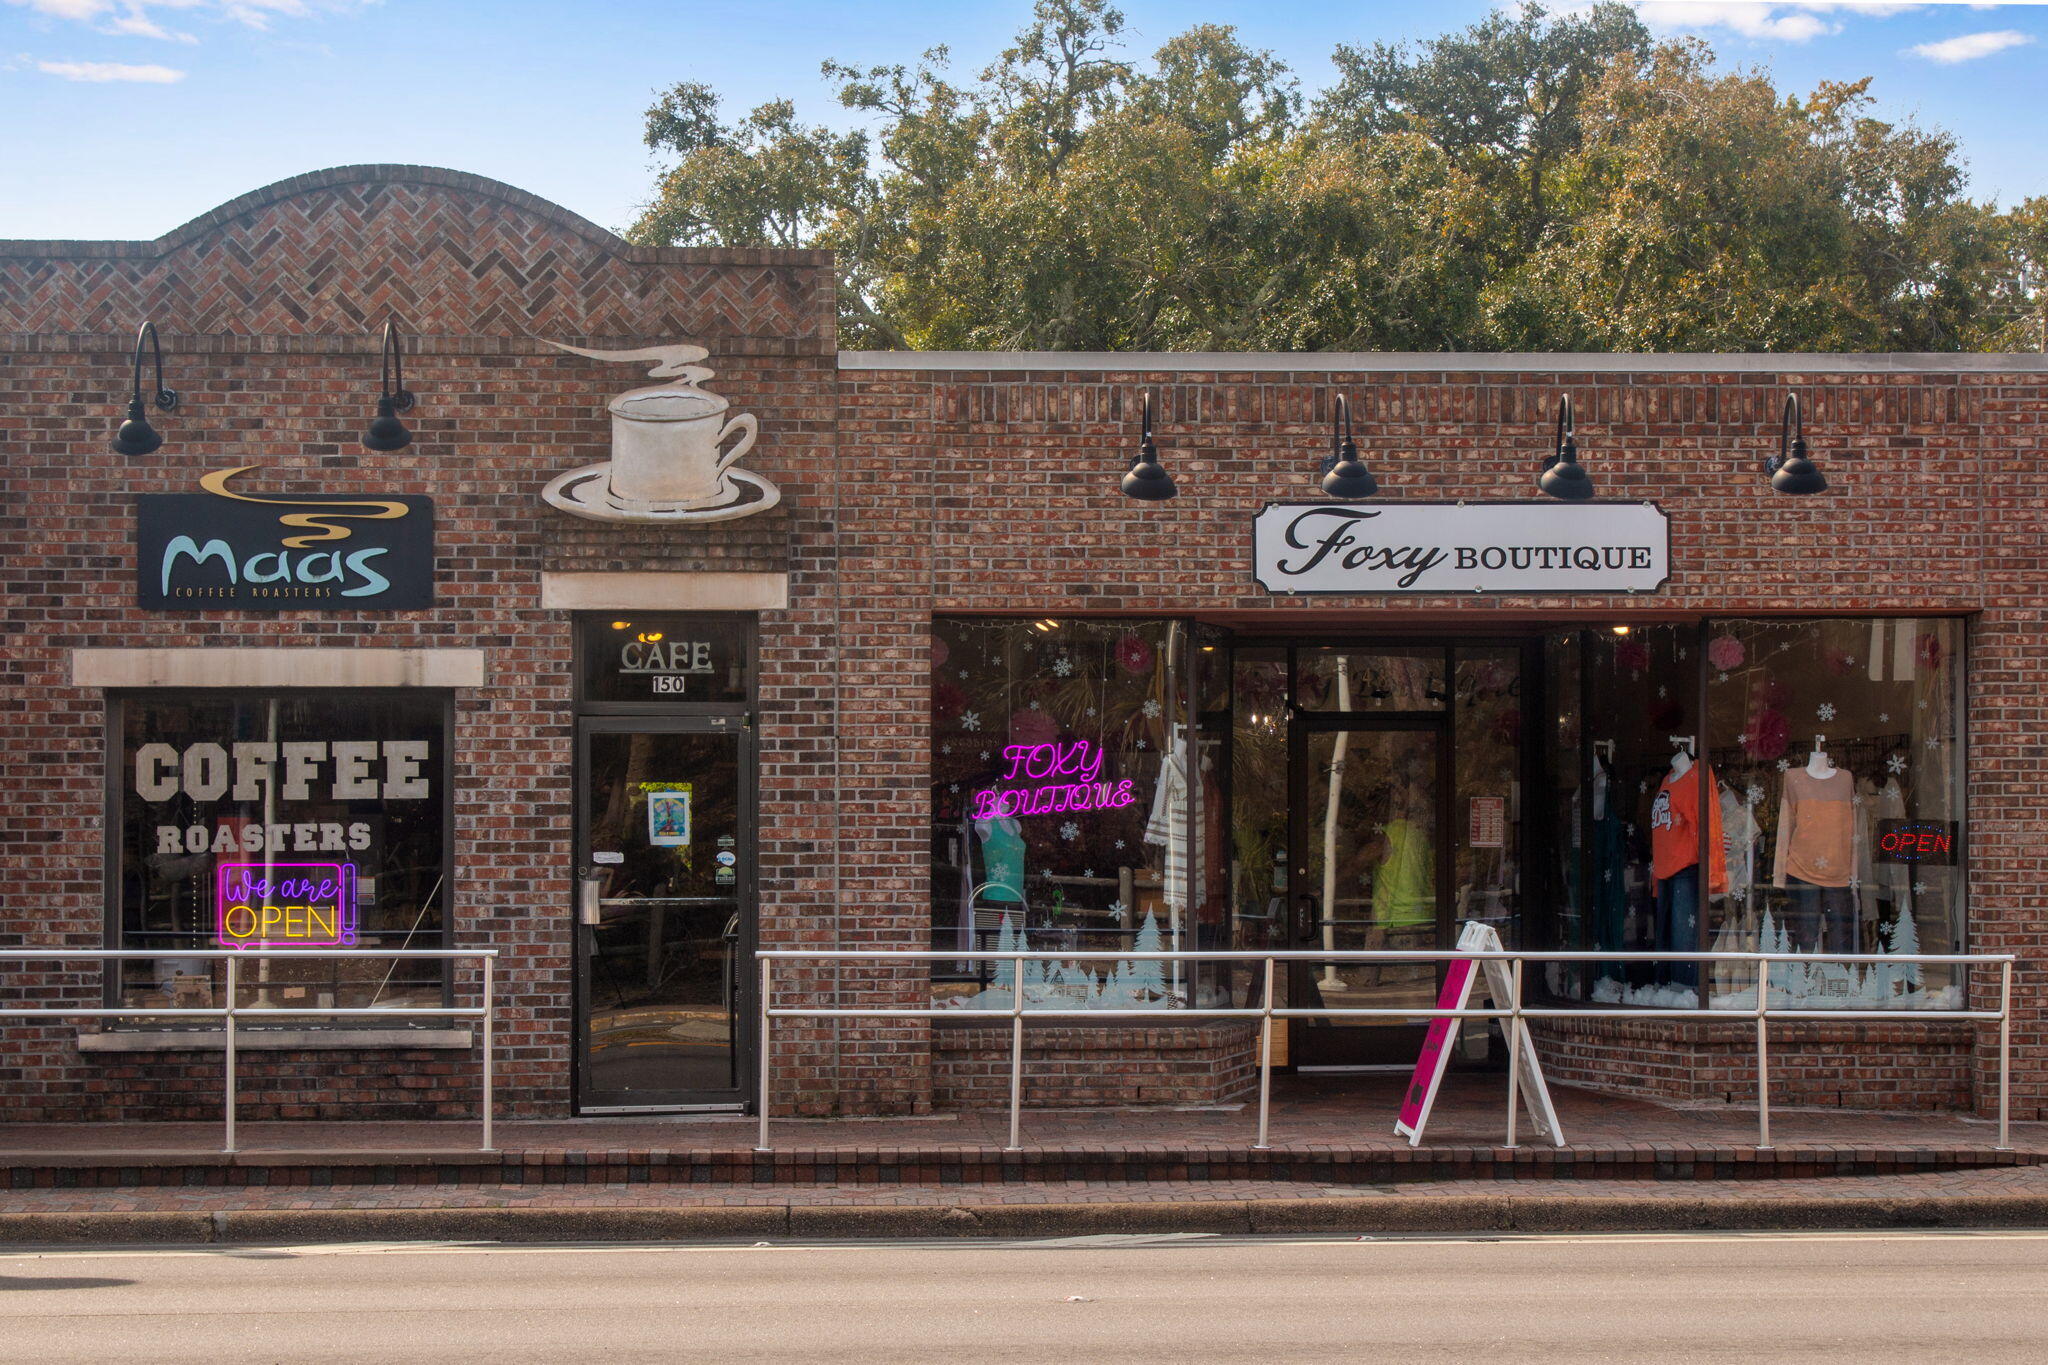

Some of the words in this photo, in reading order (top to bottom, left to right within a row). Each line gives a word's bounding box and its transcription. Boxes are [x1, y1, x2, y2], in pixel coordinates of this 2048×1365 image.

[1277, 507, 1448, 589] Foxy
[1454, 547, 1652, 571] BOUTIQUE
[162, 535, 390, 597] Maas
[176, 587, 236, 598] COFFEE
[252, 587, 332, 598] ROASTERS
[621, 641, 713, 670] CAFE
[653, 677, 684, 691] 150
[135, 740, 429, 802] COFFEE
[1002, 740, 1104, 783] FOXY
[971, 779, 1136, 821] BOUTIQUE
[156, 822, 371, 854] ROASTERS
[1880, 833, 1953, 853] OPEN
[225, 868, 276, 902] We
[281, 877, 339, 902] are
